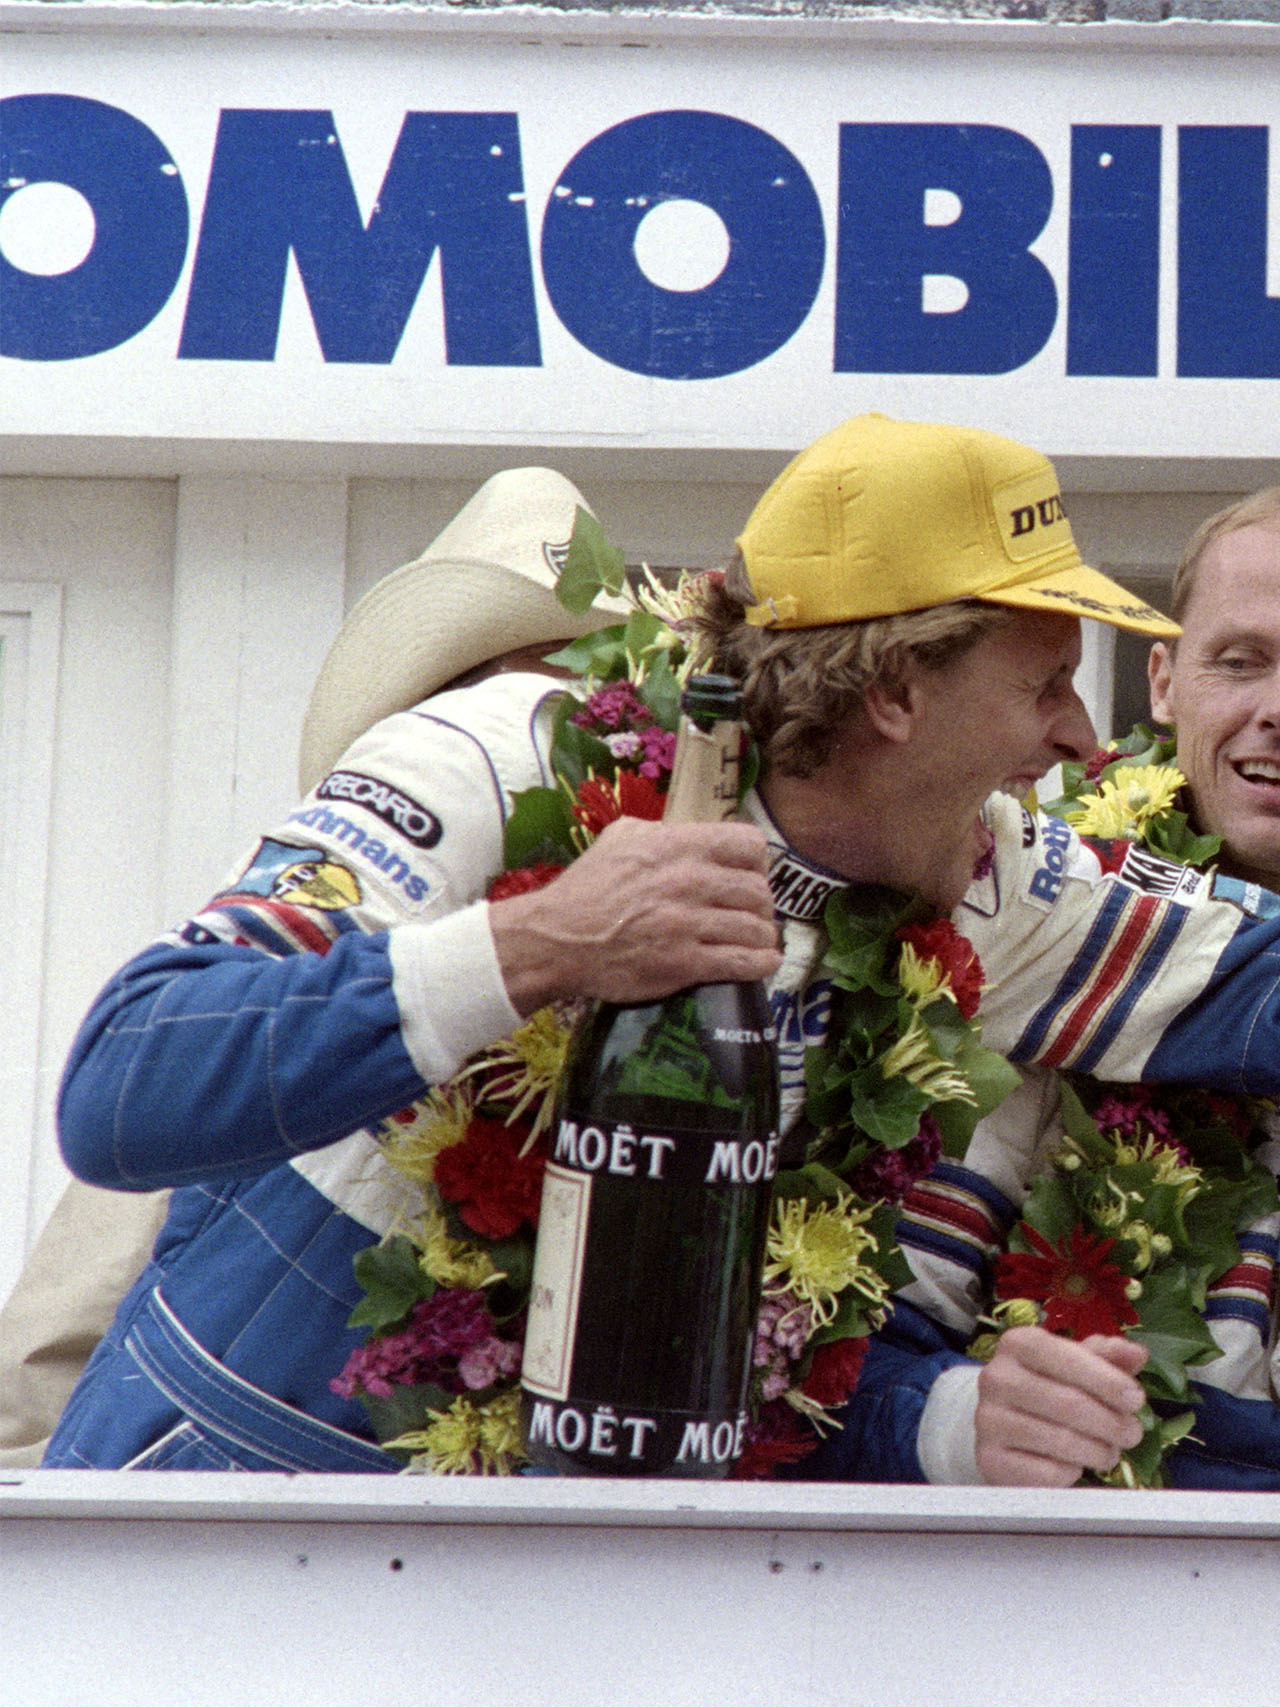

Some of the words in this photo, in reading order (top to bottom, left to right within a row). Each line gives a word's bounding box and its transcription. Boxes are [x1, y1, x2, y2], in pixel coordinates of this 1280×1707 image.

[321, 773, 434, 838] RECARO
[1028, 815, 1072, 904] Roth
[555, 1119, 676, 1180] MOËT
[529, 1401, 657, 1460] MOËT
